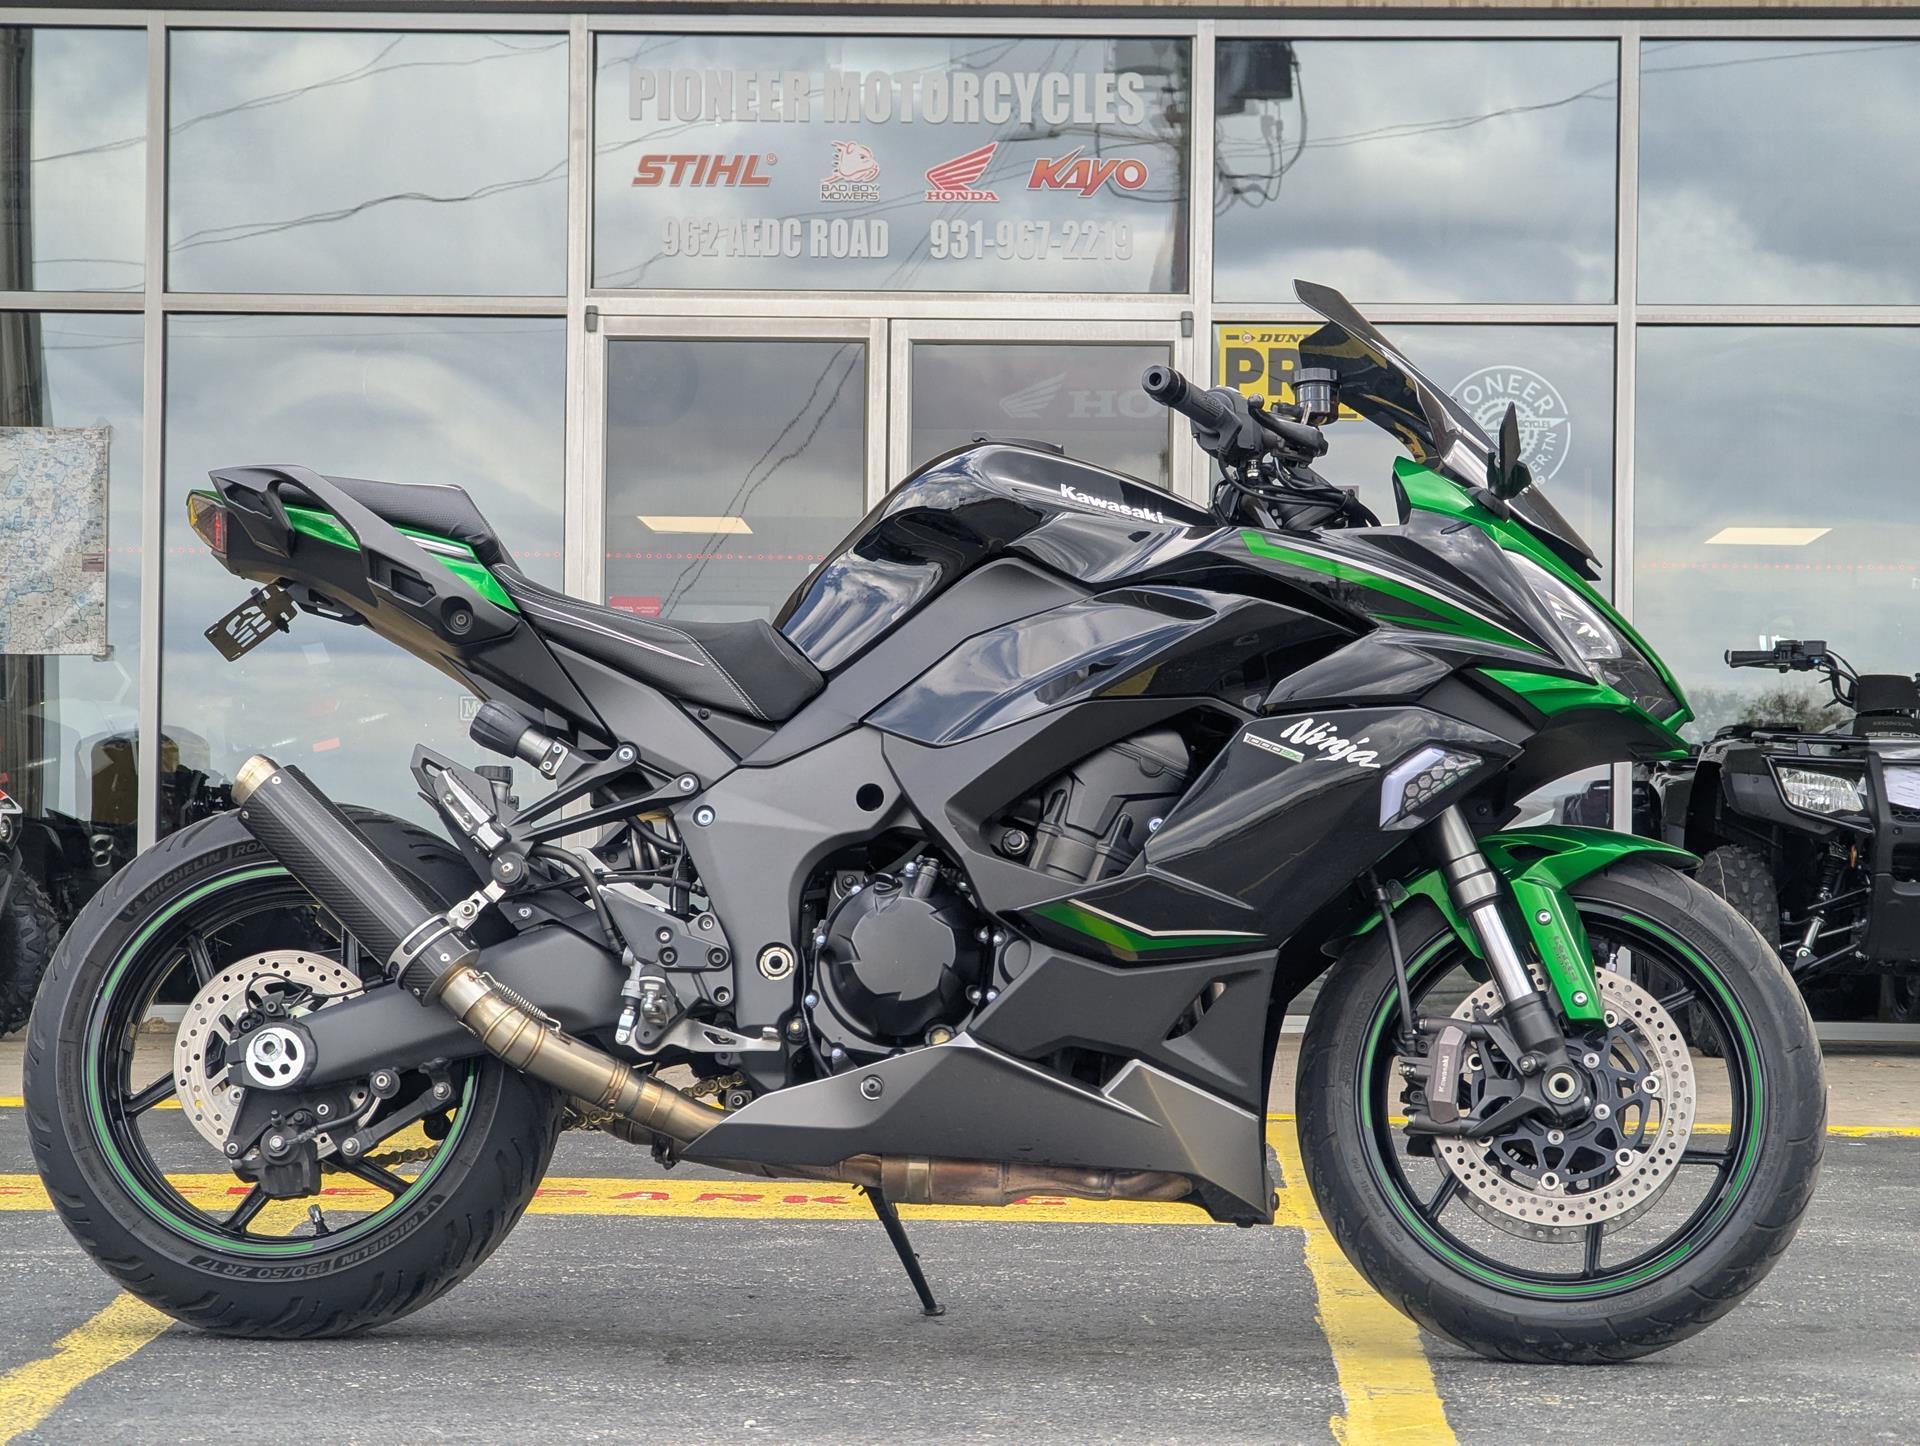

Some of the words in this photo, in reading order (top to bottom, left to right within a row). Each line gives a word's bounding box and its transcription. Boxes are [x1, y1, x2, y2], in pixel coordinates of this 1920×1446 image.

[628, 69, 811, 123] PIONEER
[823, 71, 1146, 126] MOTORCYCLES
[821, 184, 848, 192] BAD
[851, 184, 879, 192] BOY
[1027, 145, 1149, 198] KAYO
[821, 192, 879, 200] MOWERS
[926, 191, 998, 201] HONDA
[662, 216, 720, 258] 962
[726, 217, 802, 258] AEDC
[809, 218, 890, 259] ROAD
[929, 218, 1134, 261] 931-967-2219
[1257, 333, 1311, 343] DUN
[1225, 347, 1301, 396] PR
[1067, 389, 1167, 418] HO
[1463, 373, 1554, 416] ONEER
[1060, 483, 1164, 524] Kawasaki
[1280, 717, 1381, 769] Ninja
[148, 852, 222, 898] MICHELIN
[235, 841, 268, 857] ROA
[1438, 1055, 1450, 1093] Kawasaki
[341, 1214, 420, 1266] MICHELIN
[198, 1259, 222, 1272] 17
[223, 1263, 252, 1278] ZR
[256, 1258, 328, 1280] 190/50
